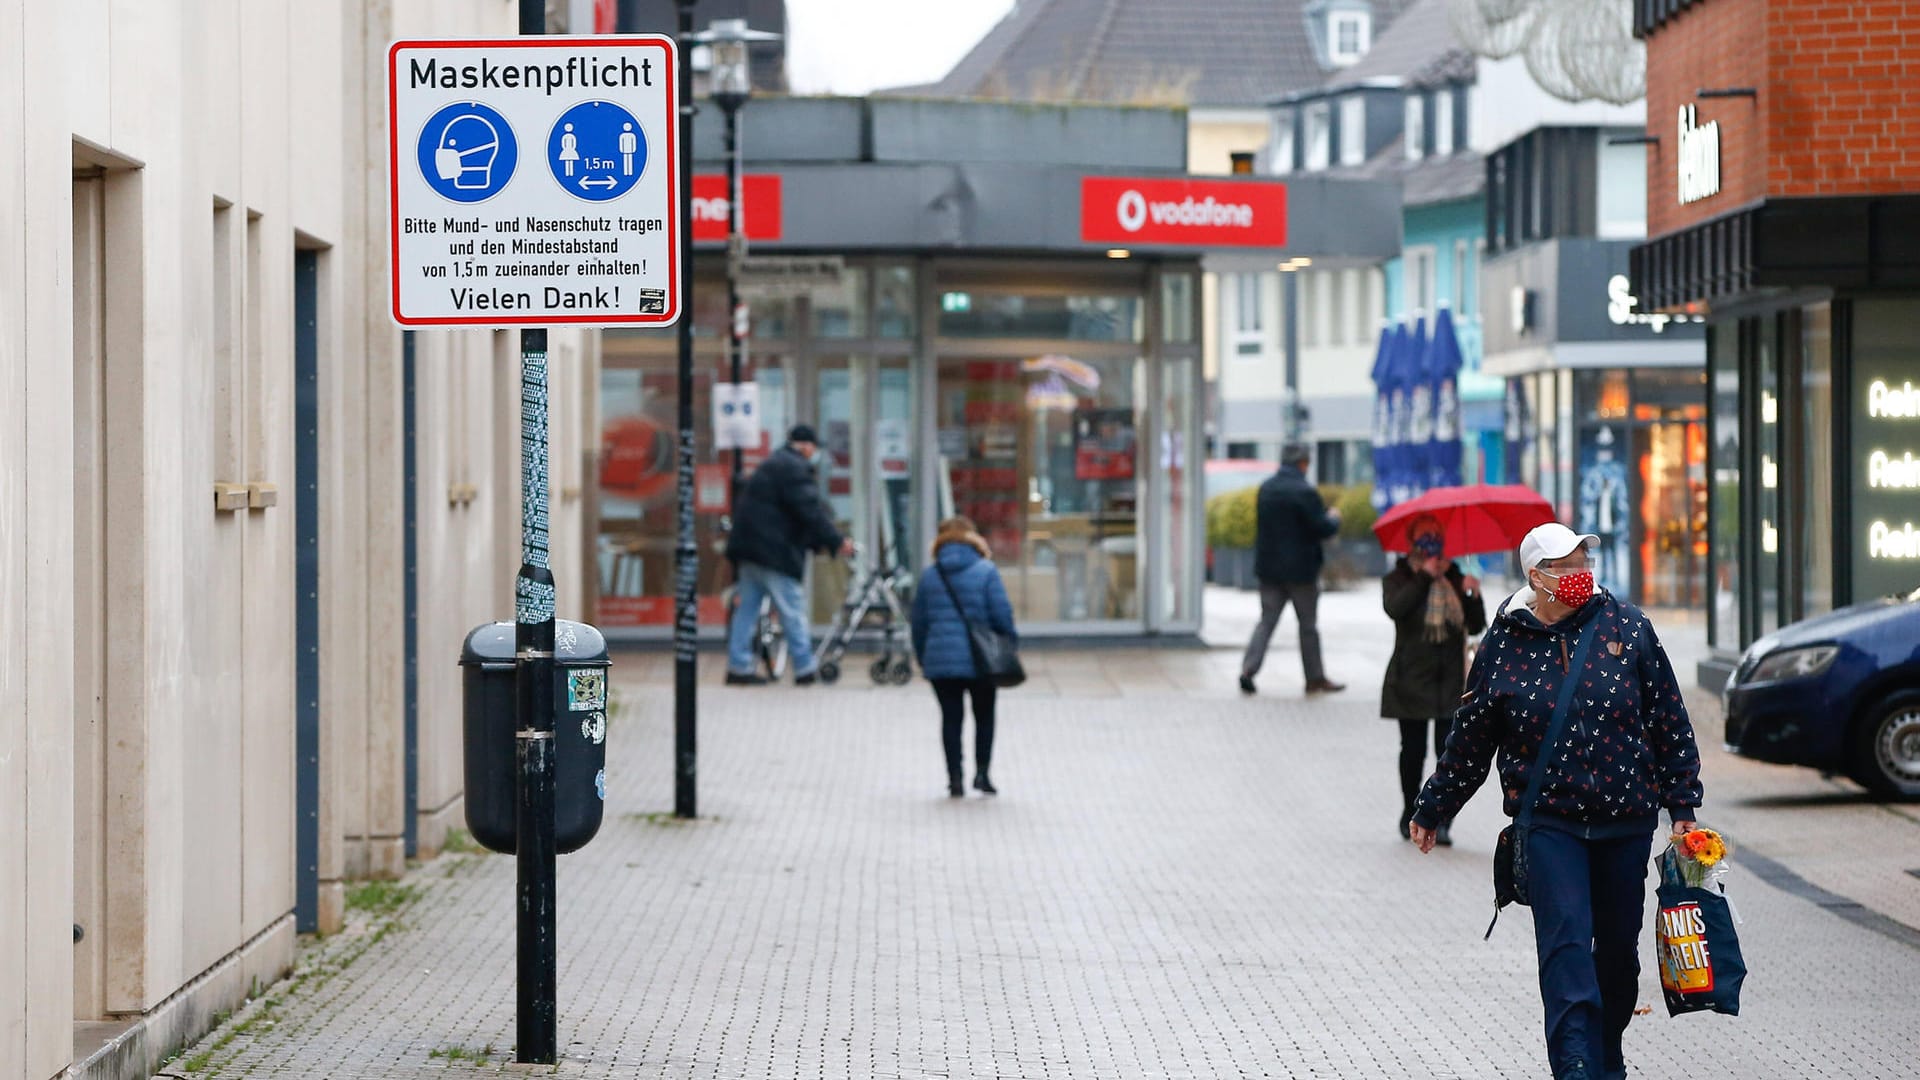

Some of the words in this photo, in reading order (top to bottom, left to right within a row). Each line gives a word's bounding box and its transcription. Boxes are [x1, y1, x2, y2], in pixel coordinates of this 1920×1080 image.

[410, 56, 652, 96] Maskenpflicht
[1150, 195, 1253, 227] vodafone
[404, 217, 437, 234] Bitte
[443, 217, 489, 234] Mund-
[495, 216, 520, 233] und
[526, 216, 611, 233] Nasenschutz
[618, 216, 662, 235] tragen
[449, 239, 474, 256] und
[480, 239, 505, 255] den
[512, 237, 618, 255] Mindestabstand
[422, 265, 447, 278] von
[495, 260, 571, 277] zueinander
[577, 259, 646, 276] einhalten!
[450, 287, 531, 310] Vielen
[544, 286, 620, 309] Dank!
